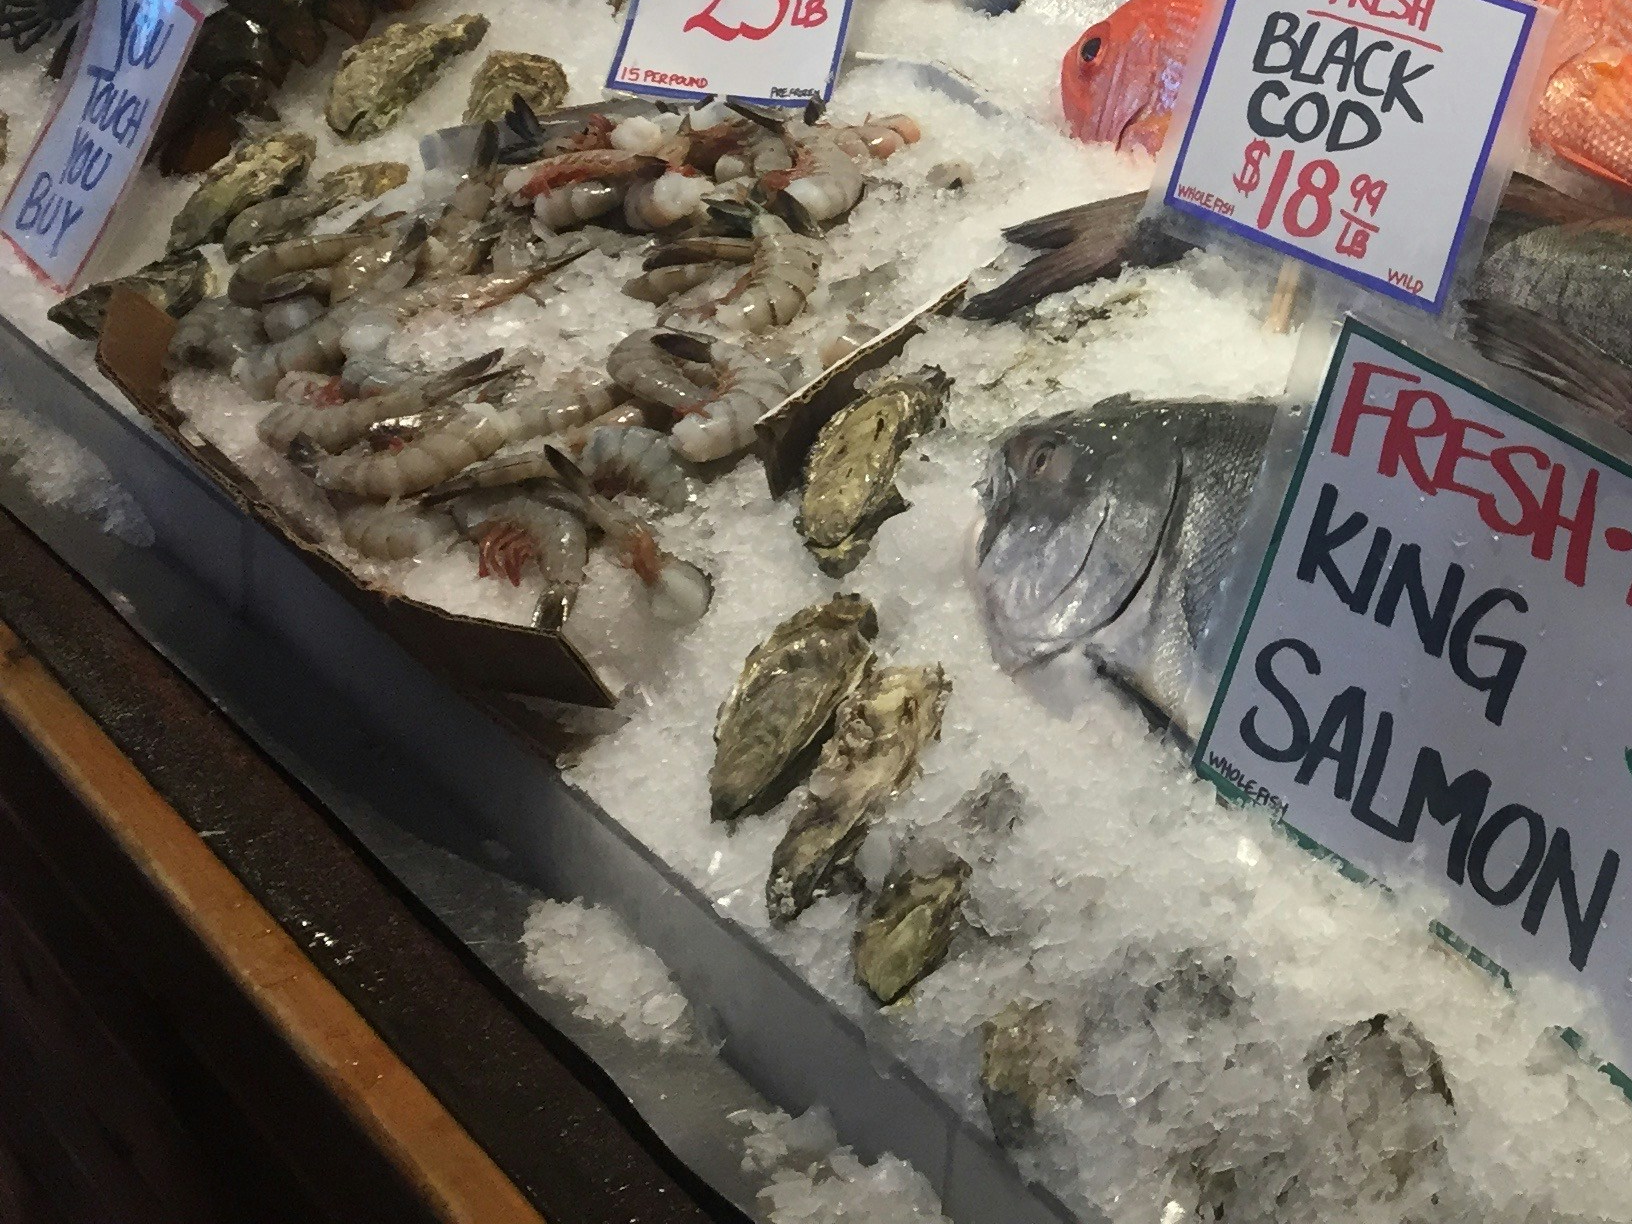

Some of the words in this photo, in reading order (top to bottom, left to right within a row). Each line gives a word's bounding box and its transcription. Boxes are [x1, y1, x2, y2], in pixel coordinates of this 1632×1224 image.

[621, 66, 641, 82] 15
[1251, 10, 1436, 124] BLACK
[86, 62, 150, 149] TOUCH
[1245, 79, 1383, 154] COD
[59, 125, 113, 193] YOU
[1231, 136, 1341, 239] $18
[14, 171, 84, 259] BUY
[1178, 184, 1215, 209] WHOLE
[1347, 173, 1389, 217] 99
[1334, 220, 1371, 260] LB
[1386, 266, 1425, 296] WILD
[1295, 481, 1530, 727] KING
[1208, 750, 1258, 796] WHOLE
[1238, 637, 1622, 973] SALMON
